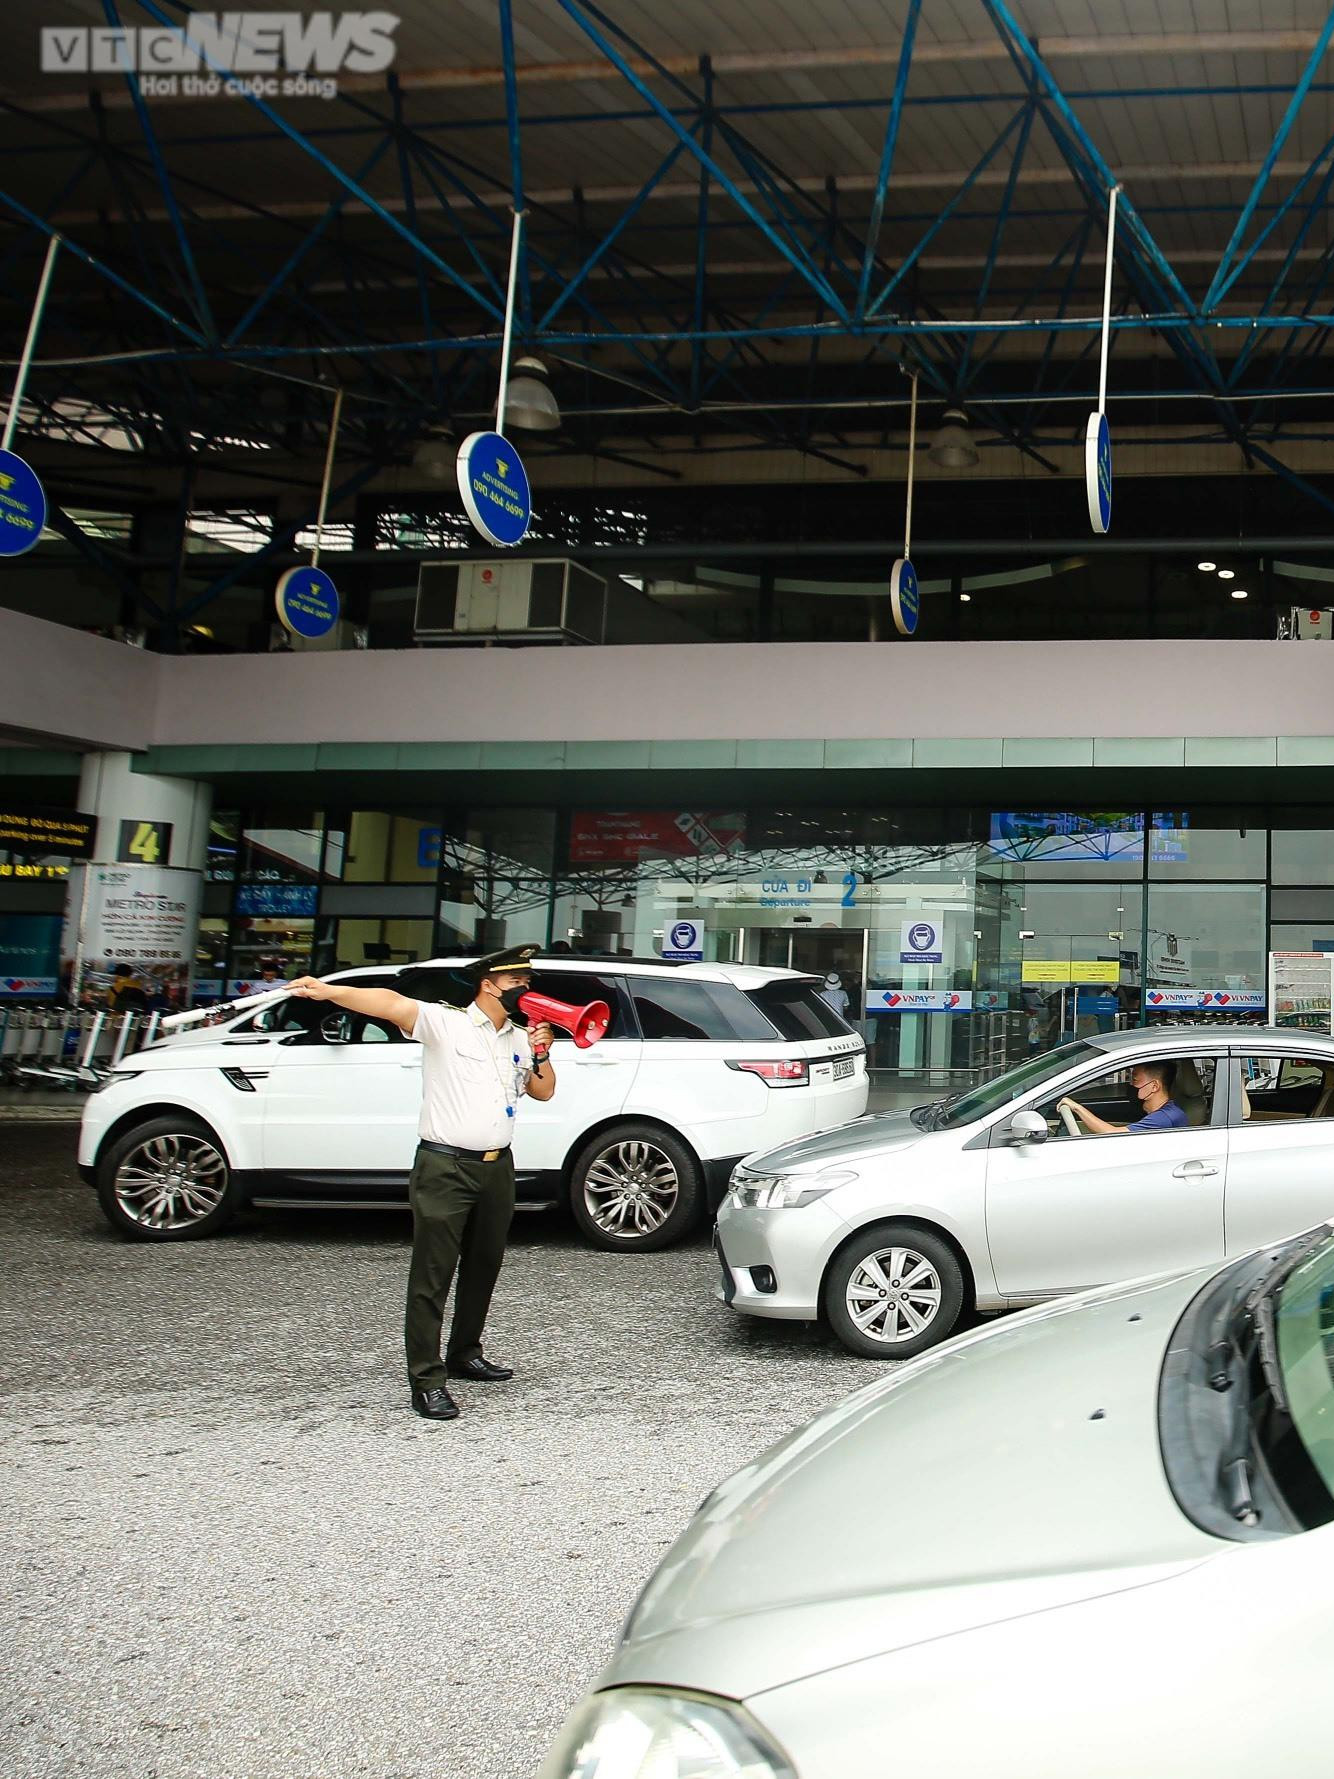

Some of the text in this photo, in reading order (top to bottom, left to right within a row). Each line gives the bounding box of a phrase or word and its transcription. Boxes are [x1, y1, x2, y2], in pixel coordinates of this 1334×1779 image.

[129, 822, 160, 863] 4
[797, 879, 812, 893] ĐI
[841, 874, 857, 907] 2
[105, 899, 156, 911] METRO
[760, 897, 811, 909] Departure
